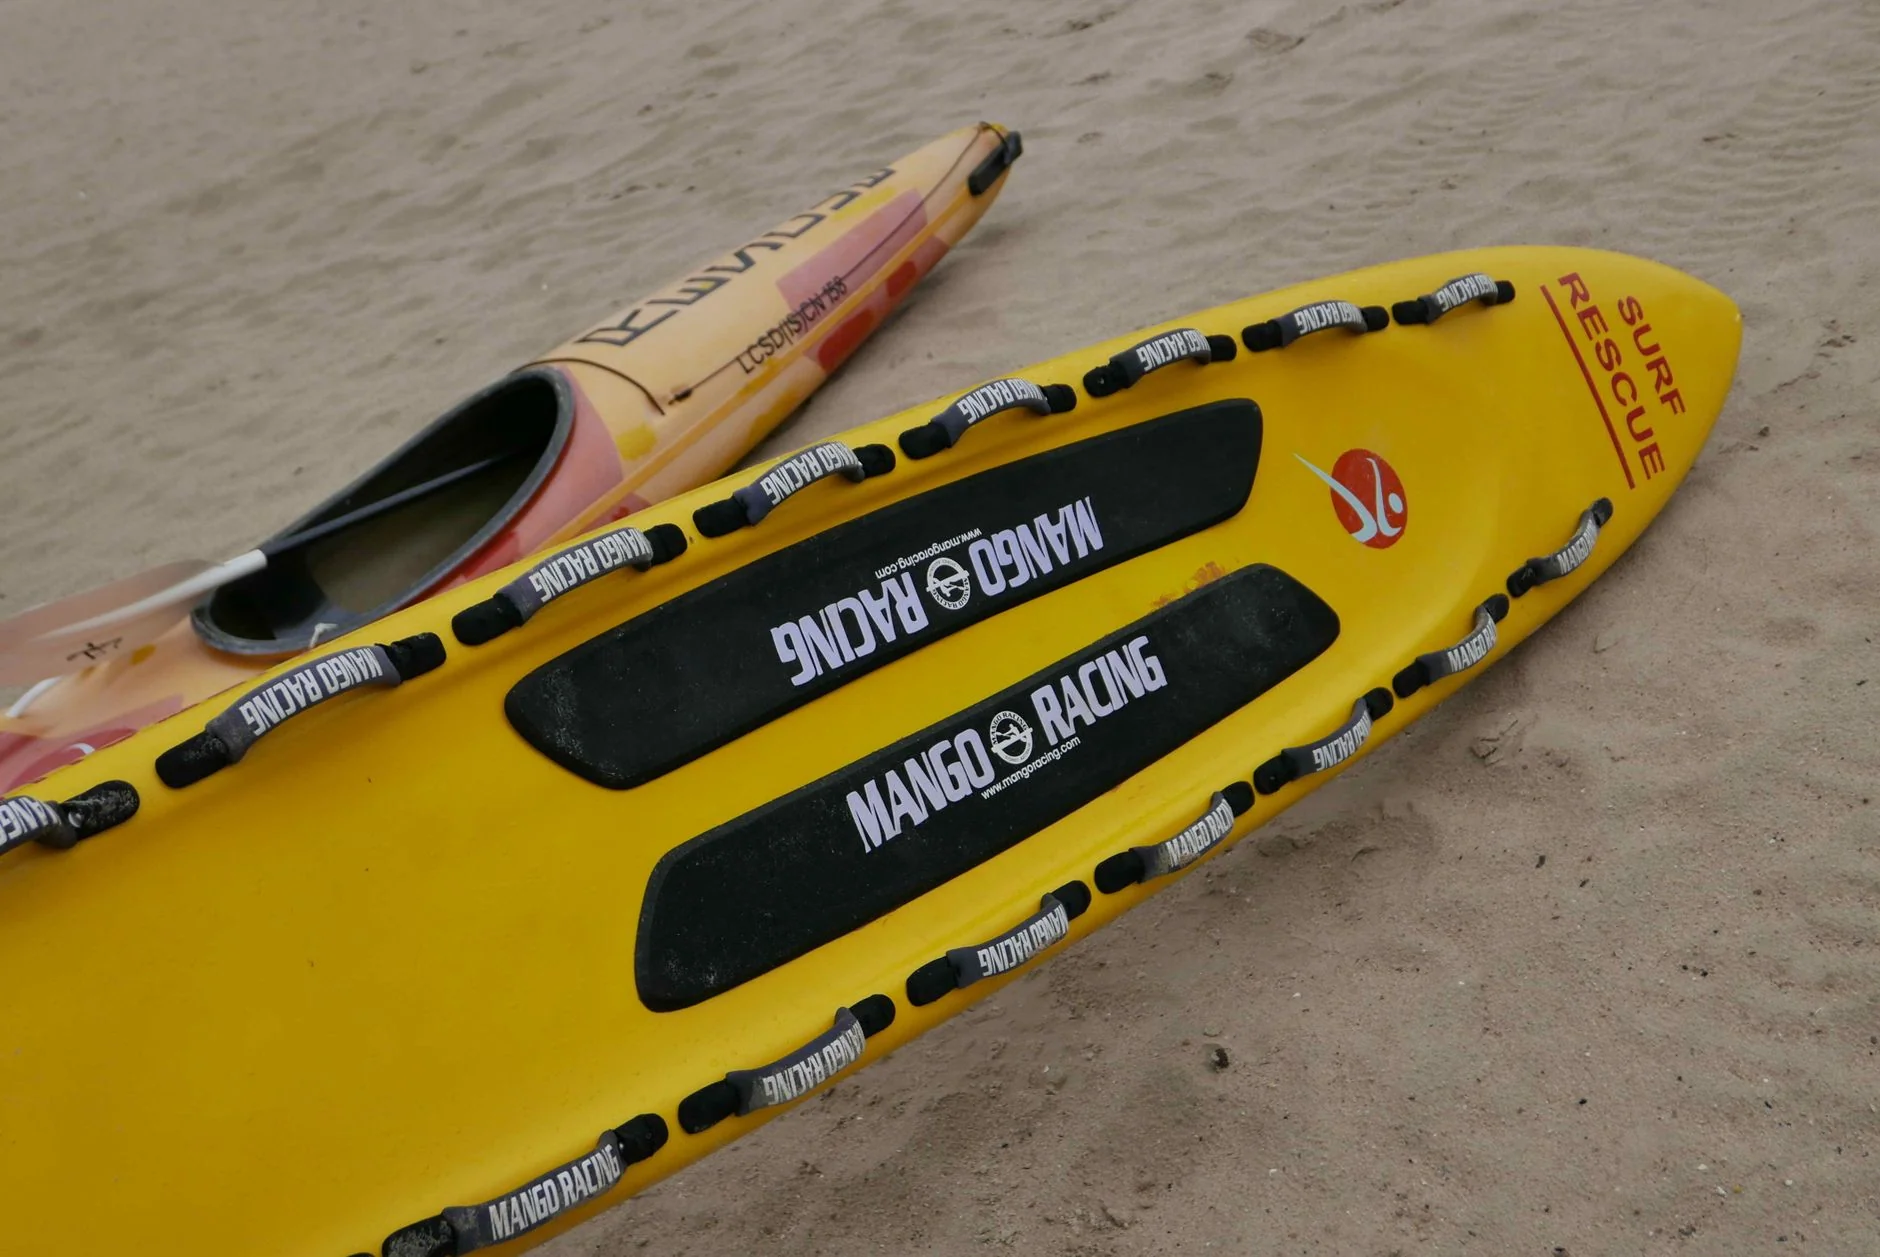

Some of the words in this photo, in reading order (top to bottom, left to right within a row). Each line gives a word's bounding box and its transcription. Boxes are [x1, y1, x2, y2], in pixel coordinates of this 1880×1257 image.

[1293, 302, 1340, 335] RACING
[1436, 275, 1480, 312] RACING
[1135, 333, 1188, 372] RACING
[1557, 272, 1666, 480] RESCUE
[1617, 295, 1686, 415] SURF
[956, 381, 1015, 424] RACING
[760, 452, 824, 505] RACING
[874, 527, 982, 580] www.mangoracing.com
[969, 496, 1105, 598] MANGO
[528, 545, 600, 603] RACING
[769, 572, 930, 687] RACING
[1447, 632, 1488, 673] MANGO
[316, 647, 383, 694] MANGO
[238, 669, 323, 737] RACING
[846, 728, 995, 853] MANGO
[1030, 636, 1168, 746] RACING
[981, 735, 1081, 800] www.mangoracing.com
[1312, 730, 1356, 772] RACING
[1165, 821, 1211, 868] MANGO
[977, 929, 1036, 977] RACING
[762, 1052, 826, 1106] RACING
[489, 1178, 560, 1241] MANGO
[557, 1143, 621, 1207] RACING
